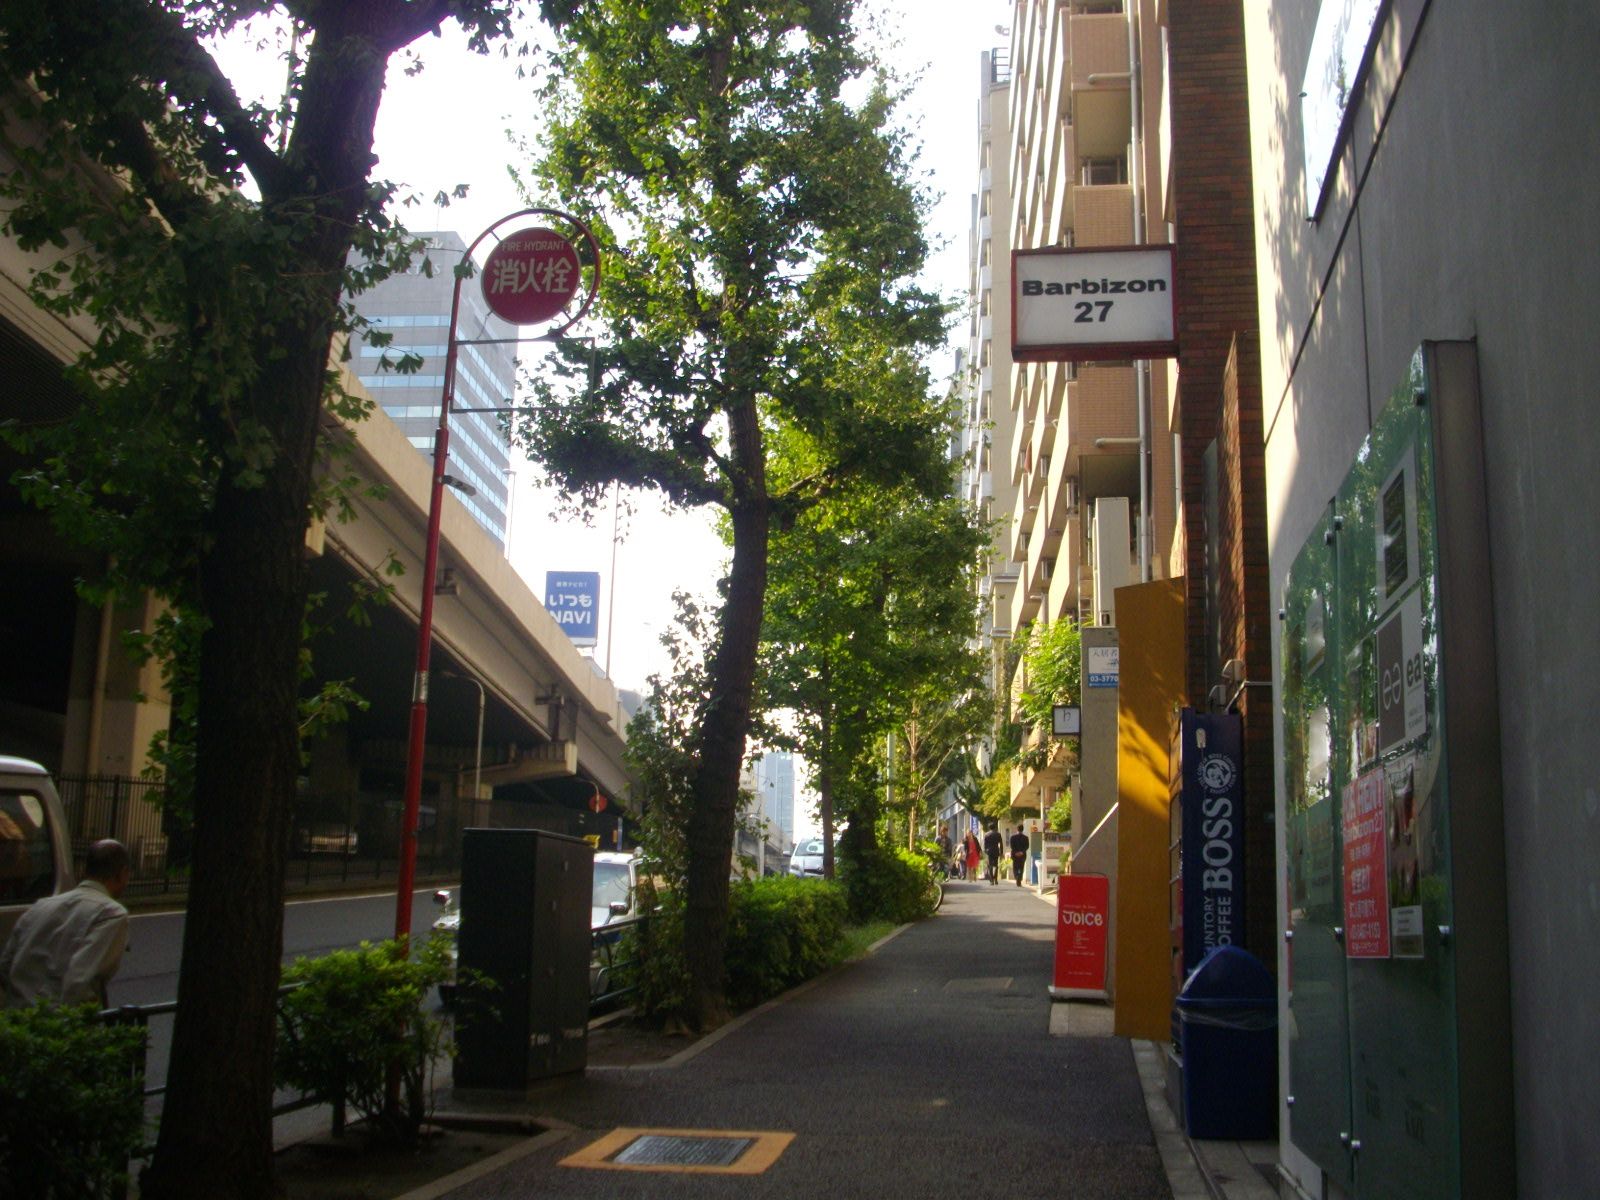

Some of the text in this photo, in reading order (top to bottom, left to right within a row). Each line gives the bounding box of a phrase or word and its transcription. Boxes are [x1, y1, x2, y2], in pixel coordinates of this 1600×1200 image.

[502, 240, 565, 251] FIRE HYDRANT
[491, 257, 572, 293] 消火栓
[1022, 279, 1166, 296] Barbizon
[1074, 301, 1114, 323] 27
[549, 593, 592, 608] いつも
[1202, 797, 1233, 891] BOSS
[1202, 895, 1216, 951] UNTORY
[1217, 895, 1232, 945] OFFEE
